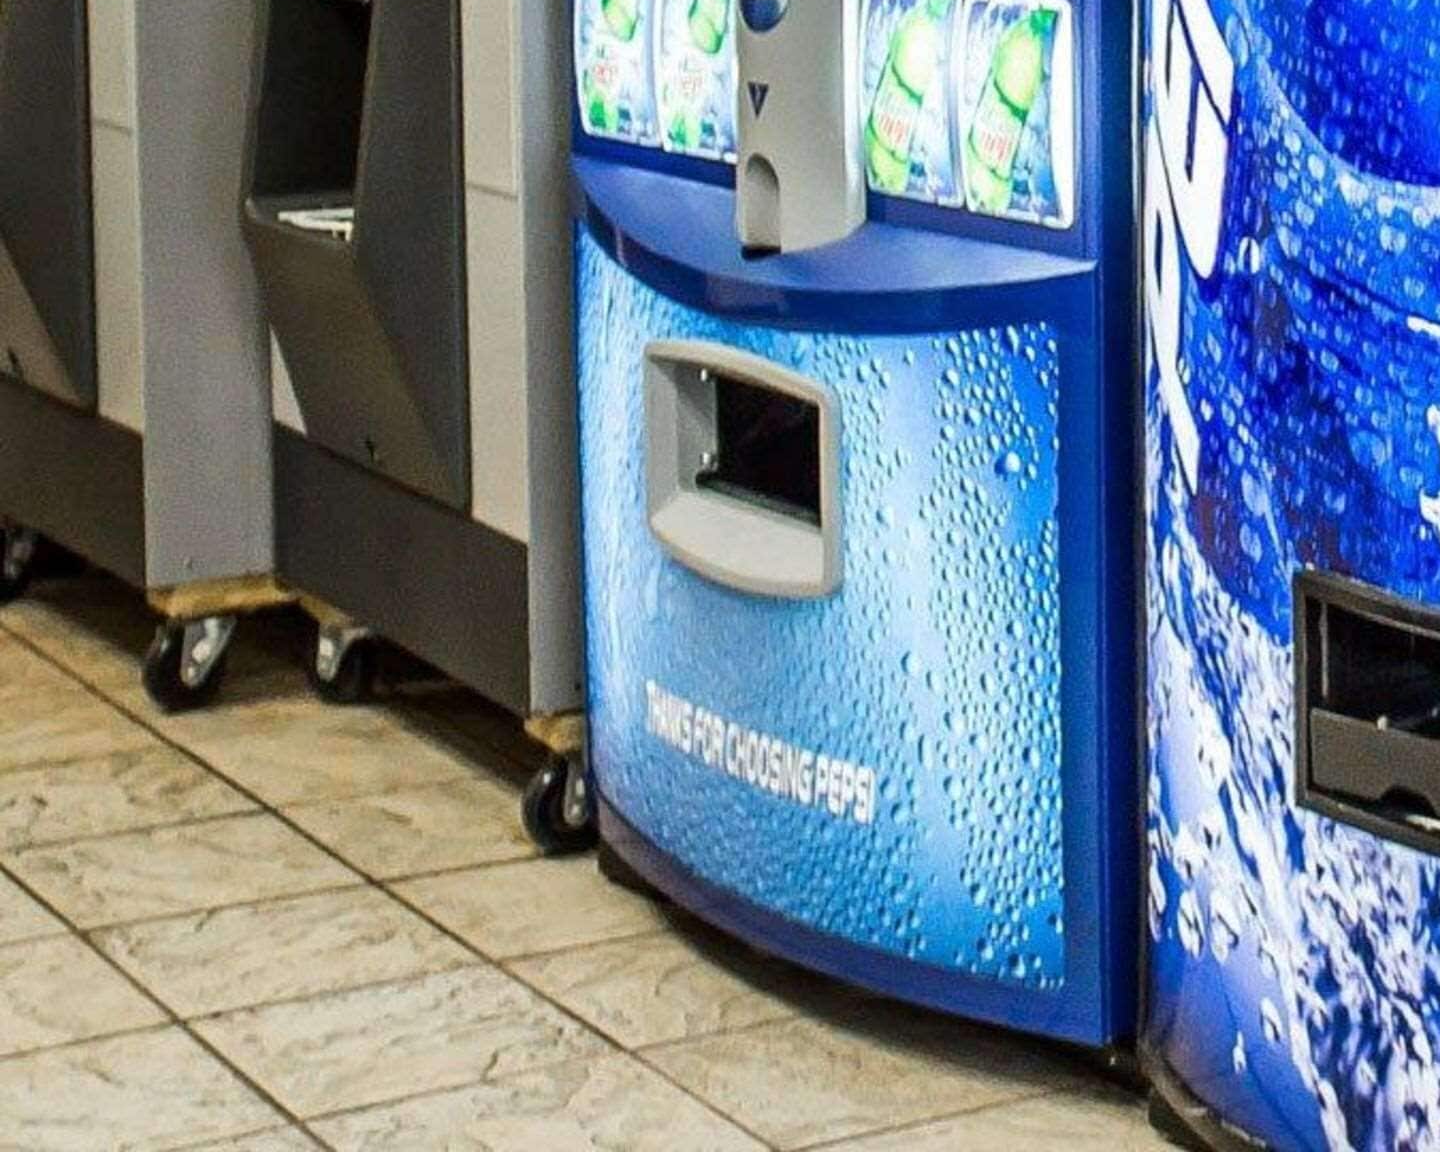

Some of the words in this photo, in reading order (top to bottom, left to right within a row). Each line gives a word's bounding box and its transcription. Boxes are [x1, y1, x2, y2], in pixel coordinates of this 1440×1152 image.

[693, 705, 726, 769] FOR
[725, 721, 814, 805] CHOOSING
[815, 752, 875, 826] PEPSI
